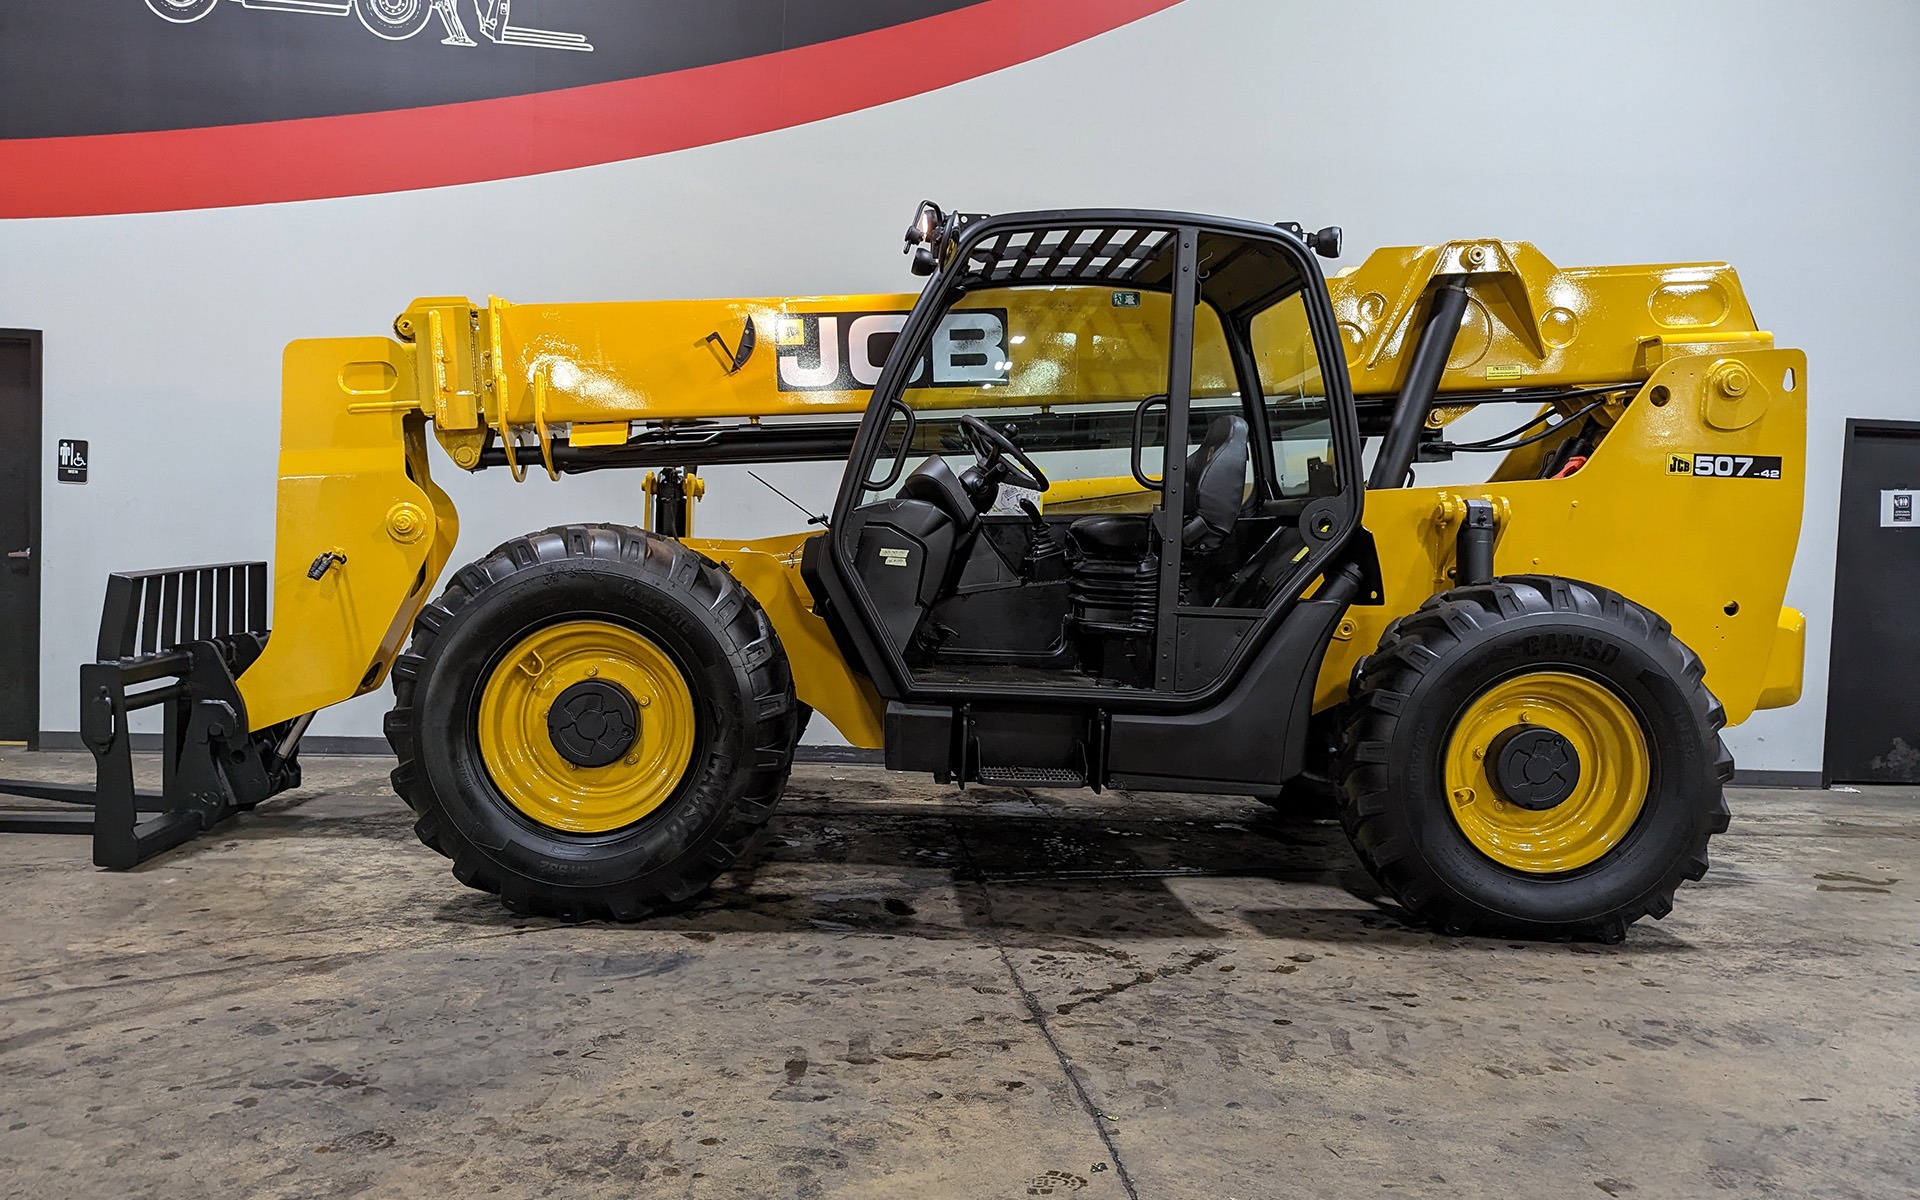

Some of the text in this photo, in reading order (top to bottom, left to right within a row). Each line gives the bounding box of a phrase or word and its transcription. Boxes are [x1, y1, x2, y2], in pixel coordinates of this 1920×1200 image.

[779, 313, 1007, 387] JCB
[1669, 456, 1691, 473] JCB
[1520, 631, 1620, 665] CAMSO
[664, 750, 733, 843] CAMSO
